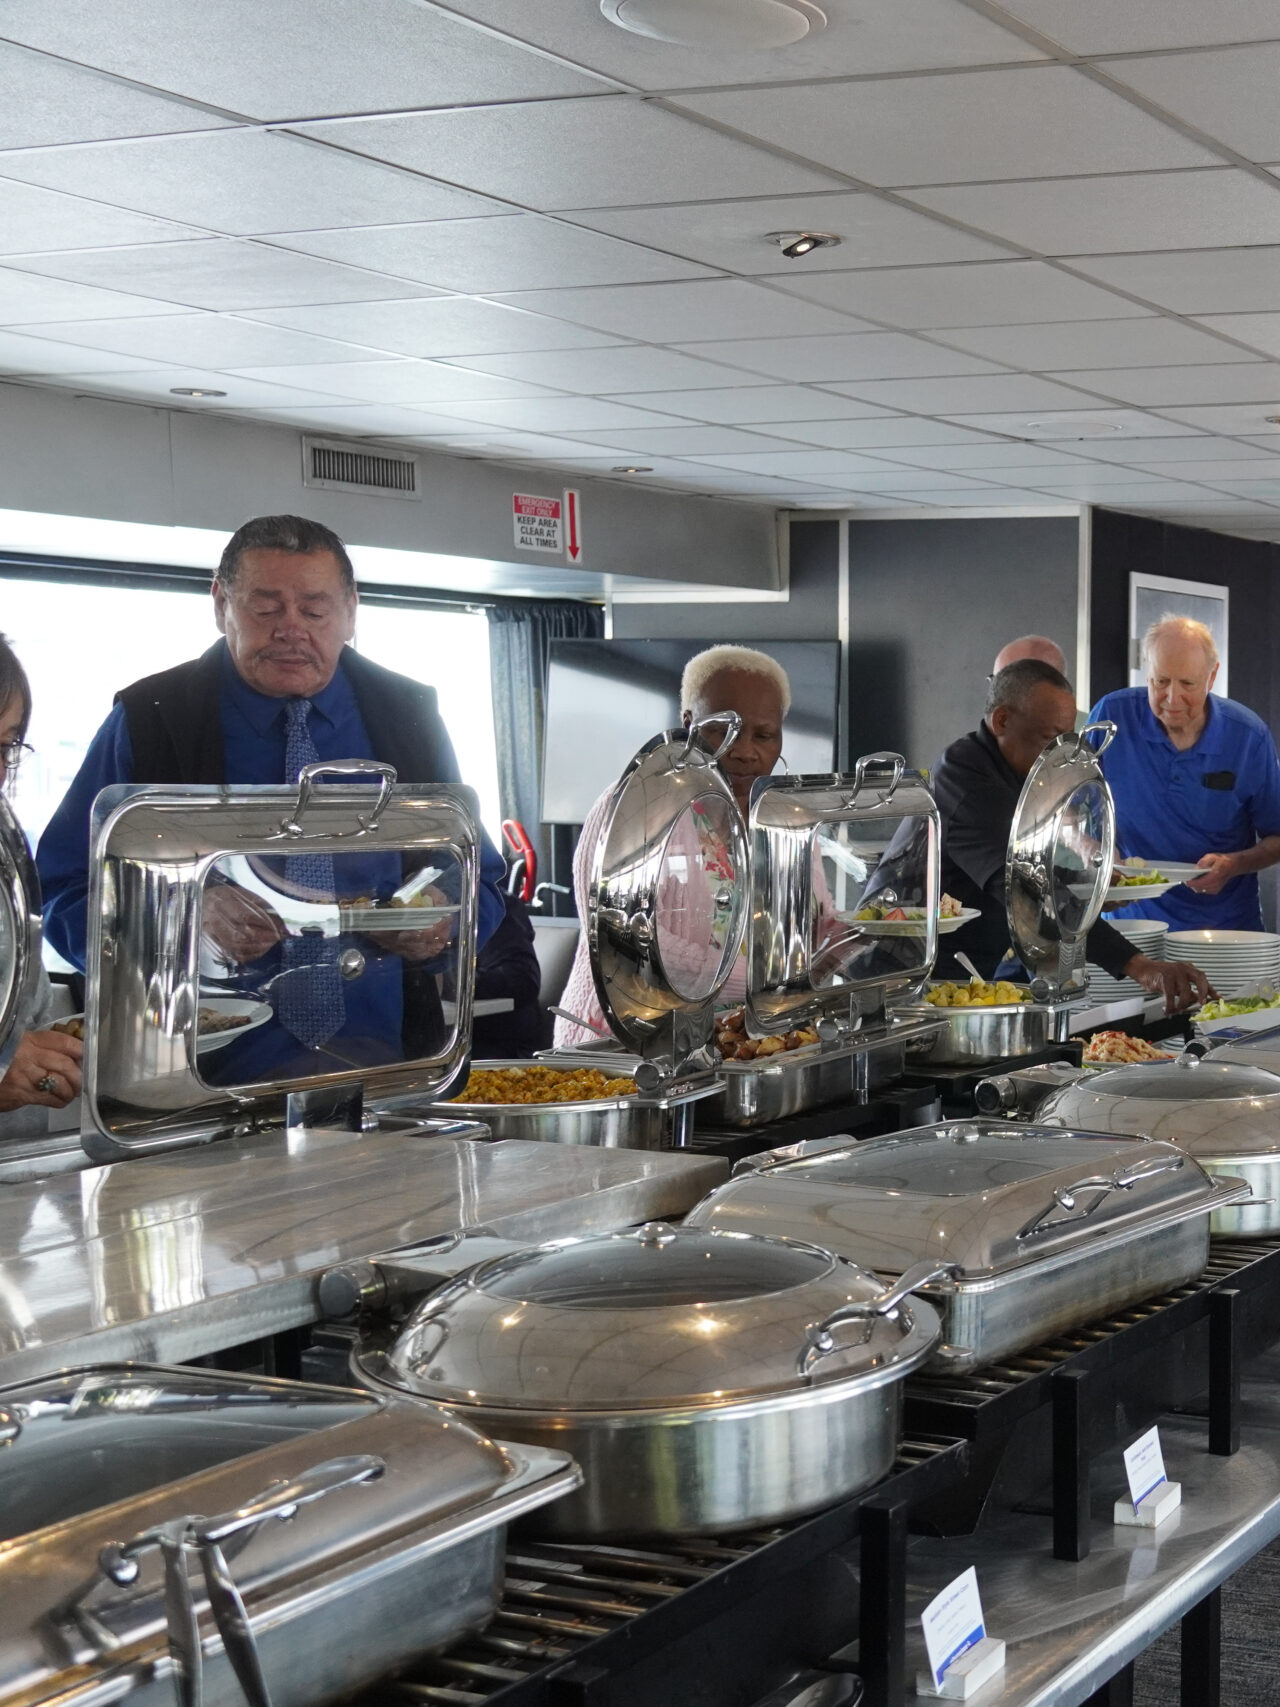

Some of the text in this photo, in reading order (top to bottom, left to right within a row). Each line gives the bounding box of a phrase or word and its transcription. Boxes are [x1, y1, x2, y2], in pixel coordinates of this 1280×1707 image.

[518, 496, 555, 509] EMERGENCY
[522, 506, 552, 517] EXIT ONLY
[517, 515, 558, 528] KEEP AREA
[520, 526, 556, 538] CLEAR AT
[520, 536, 557, 548] ALL TIMES
